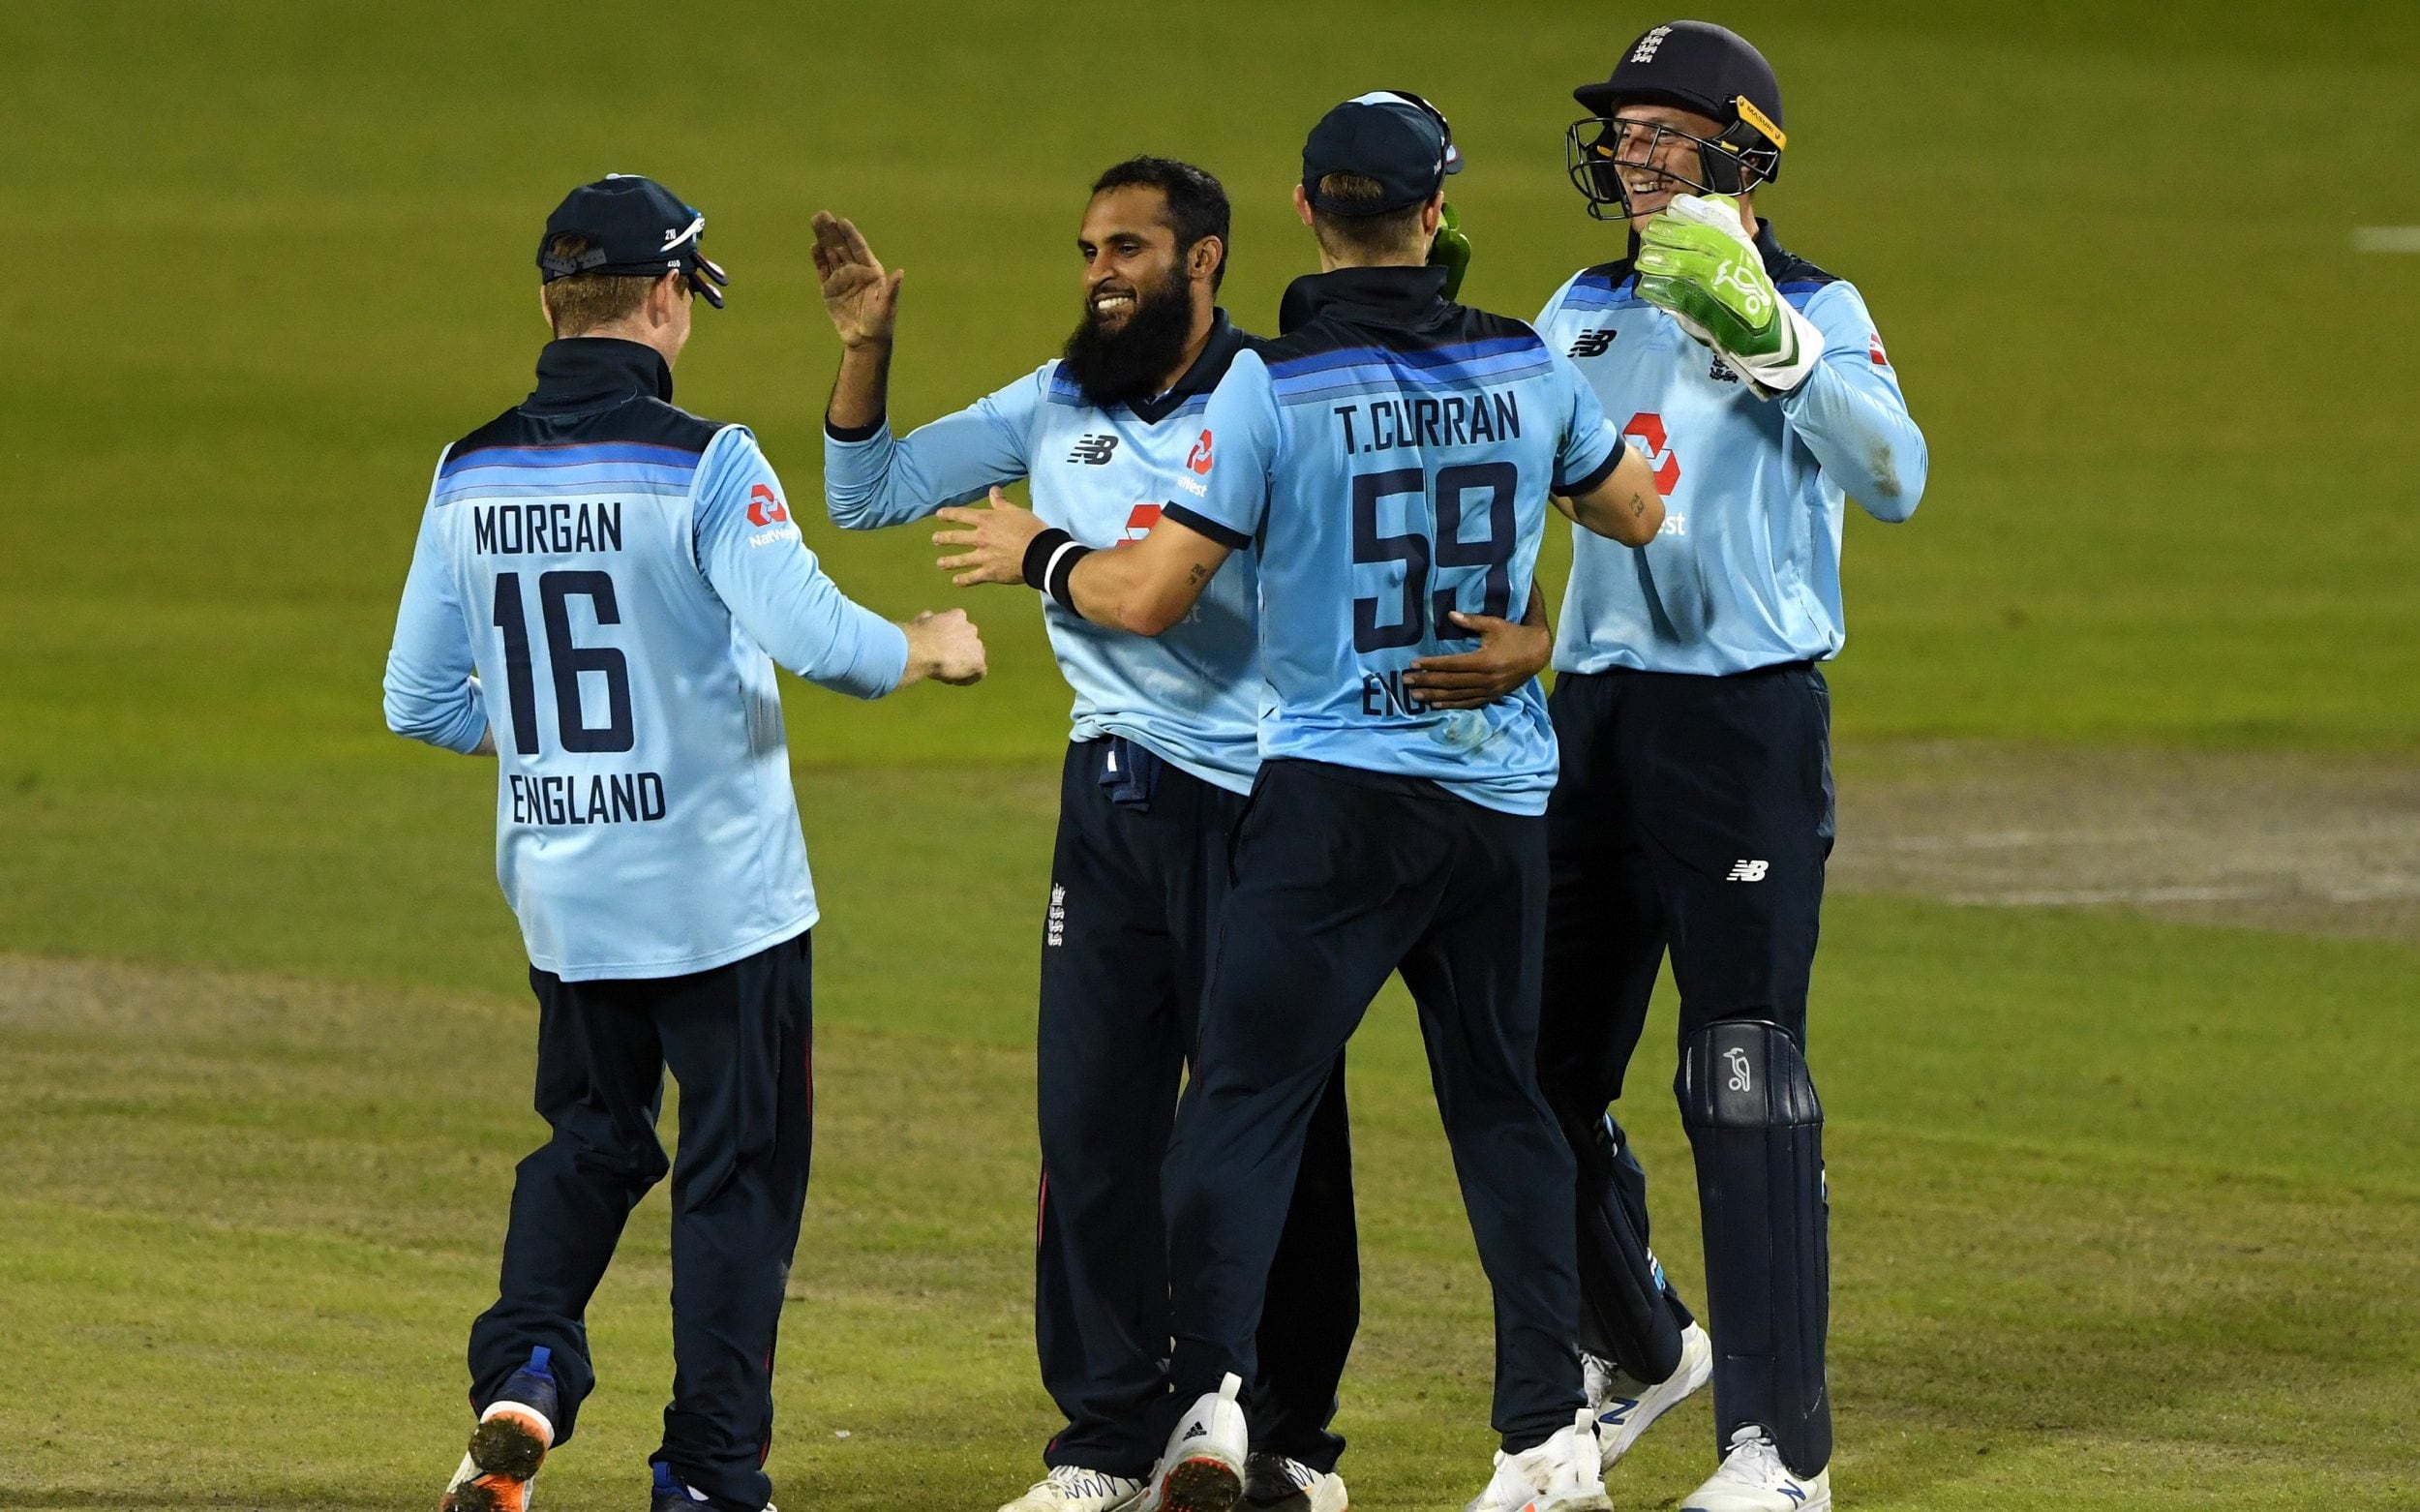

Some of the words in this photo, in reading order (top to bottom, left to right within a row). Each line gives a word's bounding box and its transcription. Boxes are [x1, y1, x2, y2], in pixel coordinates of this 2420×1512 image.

[1334, 390, 1521, 455] T.CURRAN
[473, 501, 622, 556] MORGAN
[1351, 461, 1518, 654] 59
[493, 570, 635, 755] 16
[1362, 668, 1428, 716] ENG
[509, 771, 667, 826] ENGLAND
